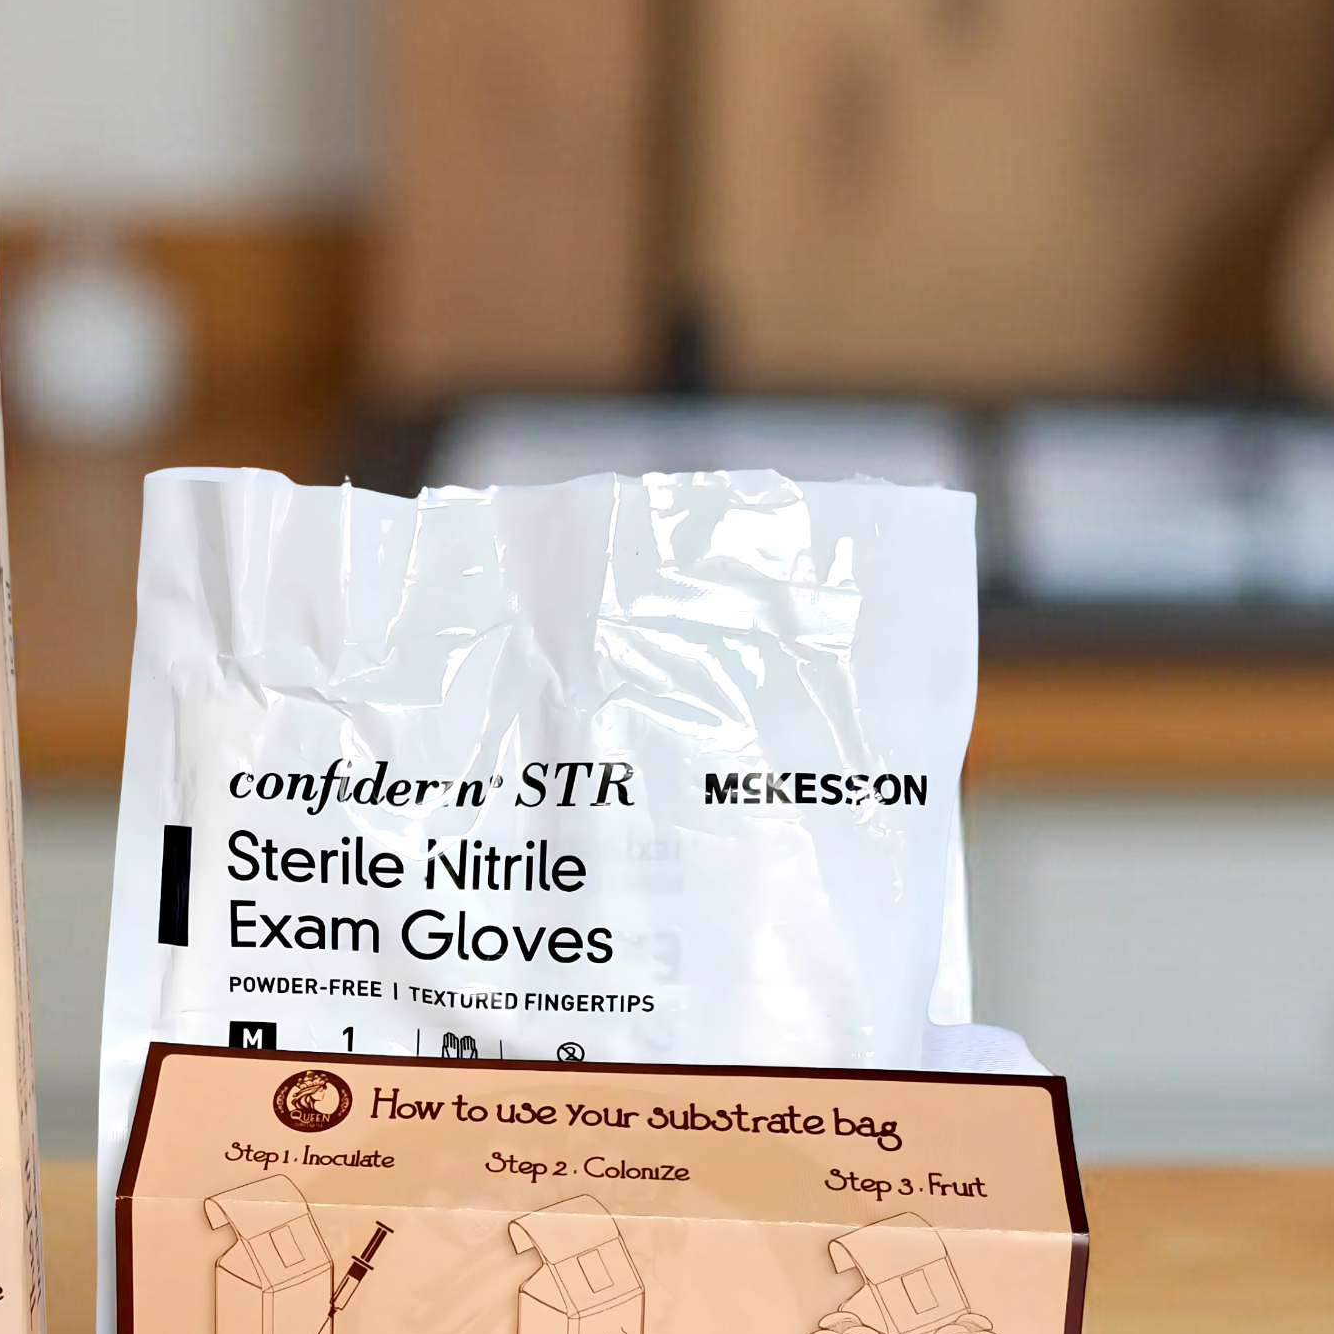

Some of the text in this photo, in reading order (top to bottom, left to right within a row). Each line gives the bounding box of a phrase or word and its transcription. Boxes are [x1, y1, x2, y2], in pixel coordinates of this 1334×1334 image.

[514, 760, 637, 808] STR
[227, 828, 587, 893] Sterile Nitrile
[231, 900, 613, 963] Exam Gloves
[230, 977, 654, 1012] POWDER-FREE TEXTURED FINGERTIPS
[243, 1026, 355, 1052] M 1
[371, 1088, 902, 1151] How to use your substrate bag
[225, 1142, 279, 1170] Step
[302, 1145, 394, 1168] Inoculate
[485, 1152, 690, 1183] Step 2 Colonize
[825, 1169, 987, 1201] Step 3 Fruit
